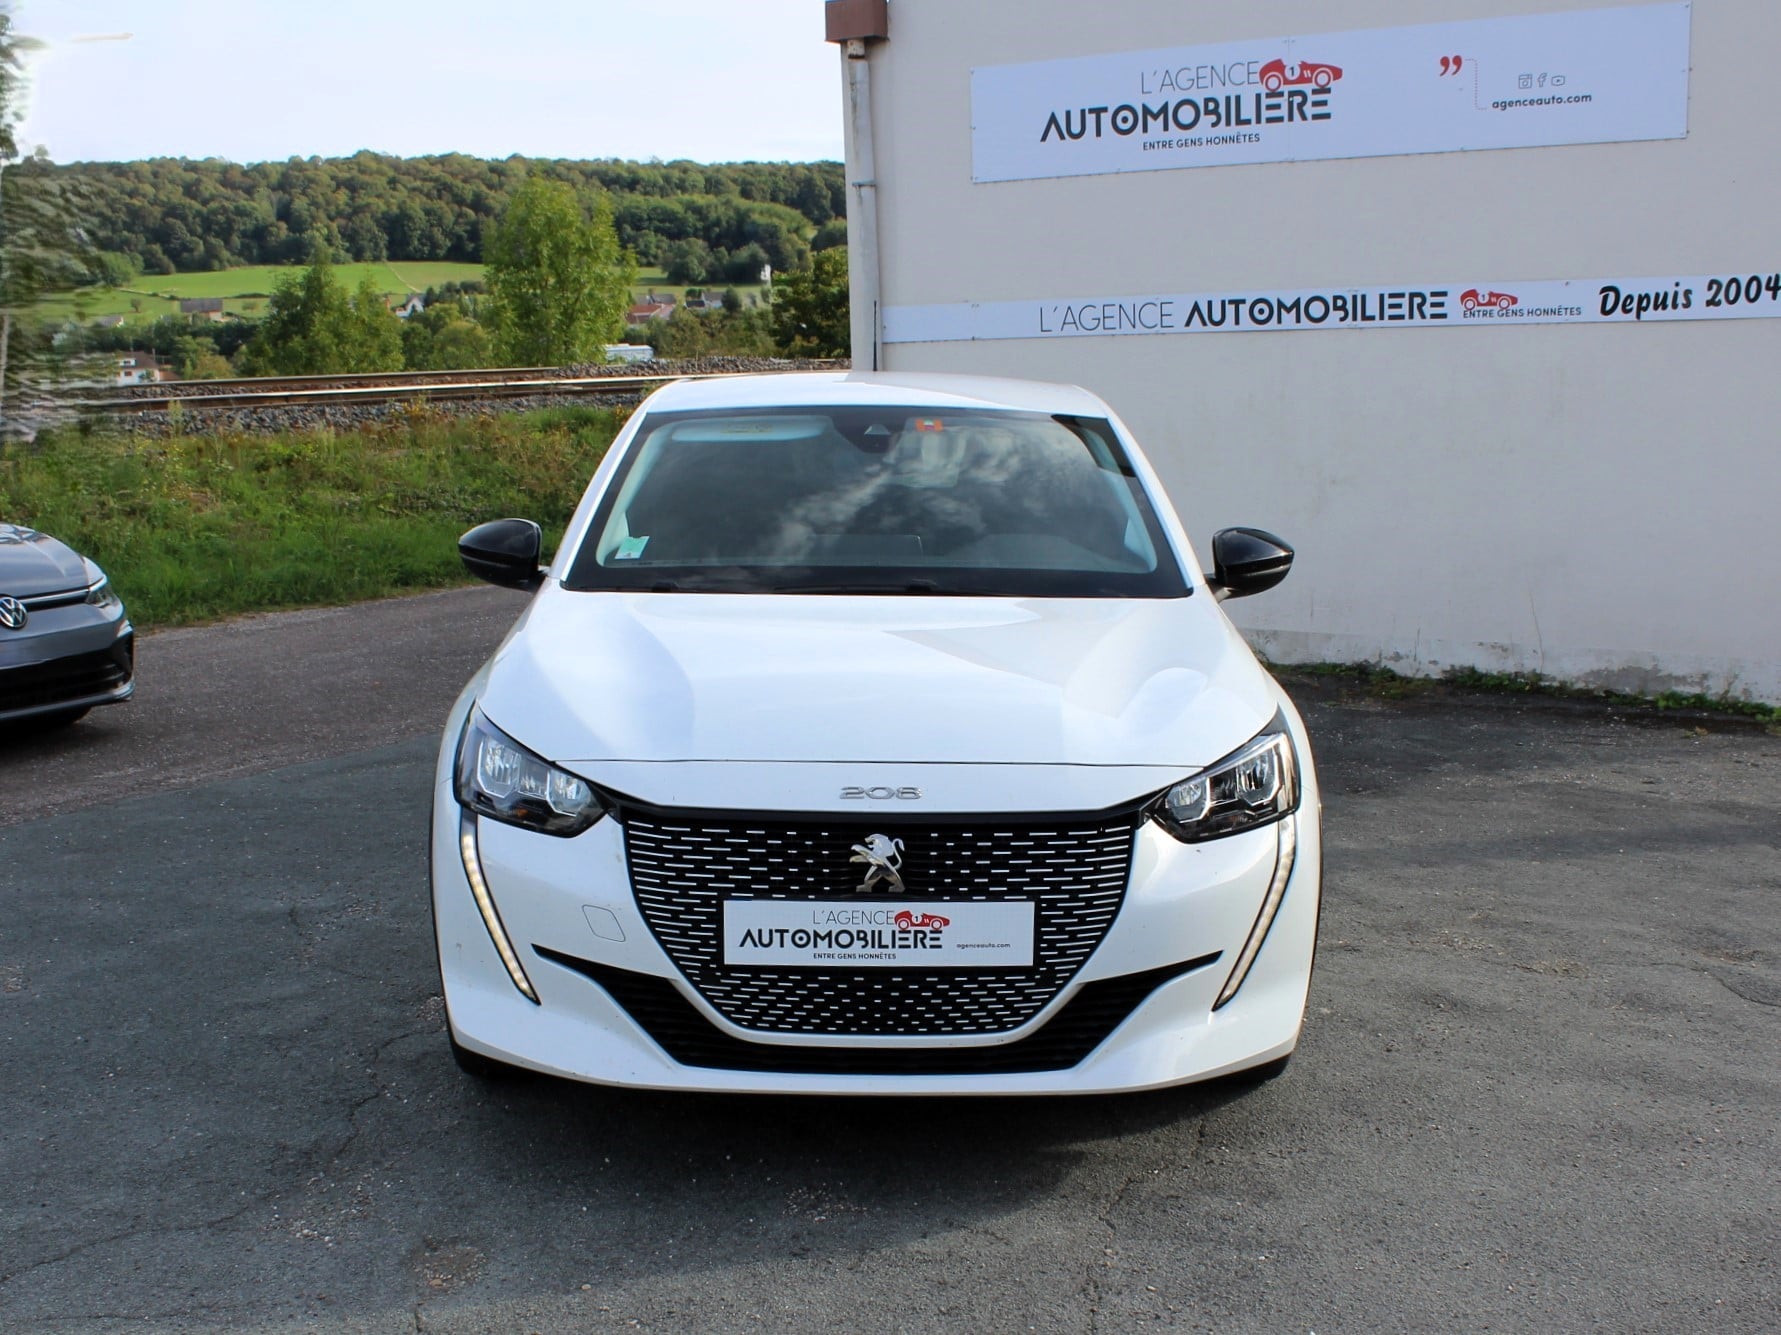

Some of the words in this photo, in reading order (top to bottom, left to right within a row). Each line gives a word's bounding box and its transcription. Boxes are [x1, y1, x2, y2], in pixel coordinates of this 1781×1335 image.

[1492, 94, 1592, 111] agenceauto.com
[1143, 140, 1174, 151] ENTRE
[1176, 138, 1203, 148] GENS
[1463, 309, 1494, 318] ENTRE
[1497, 308, 1524, 317] GENS
[1600, 282, 1693, 321] Depuis
[1706, 273, 1781, 307] 2004
[840, 787, 923, 800] 208
